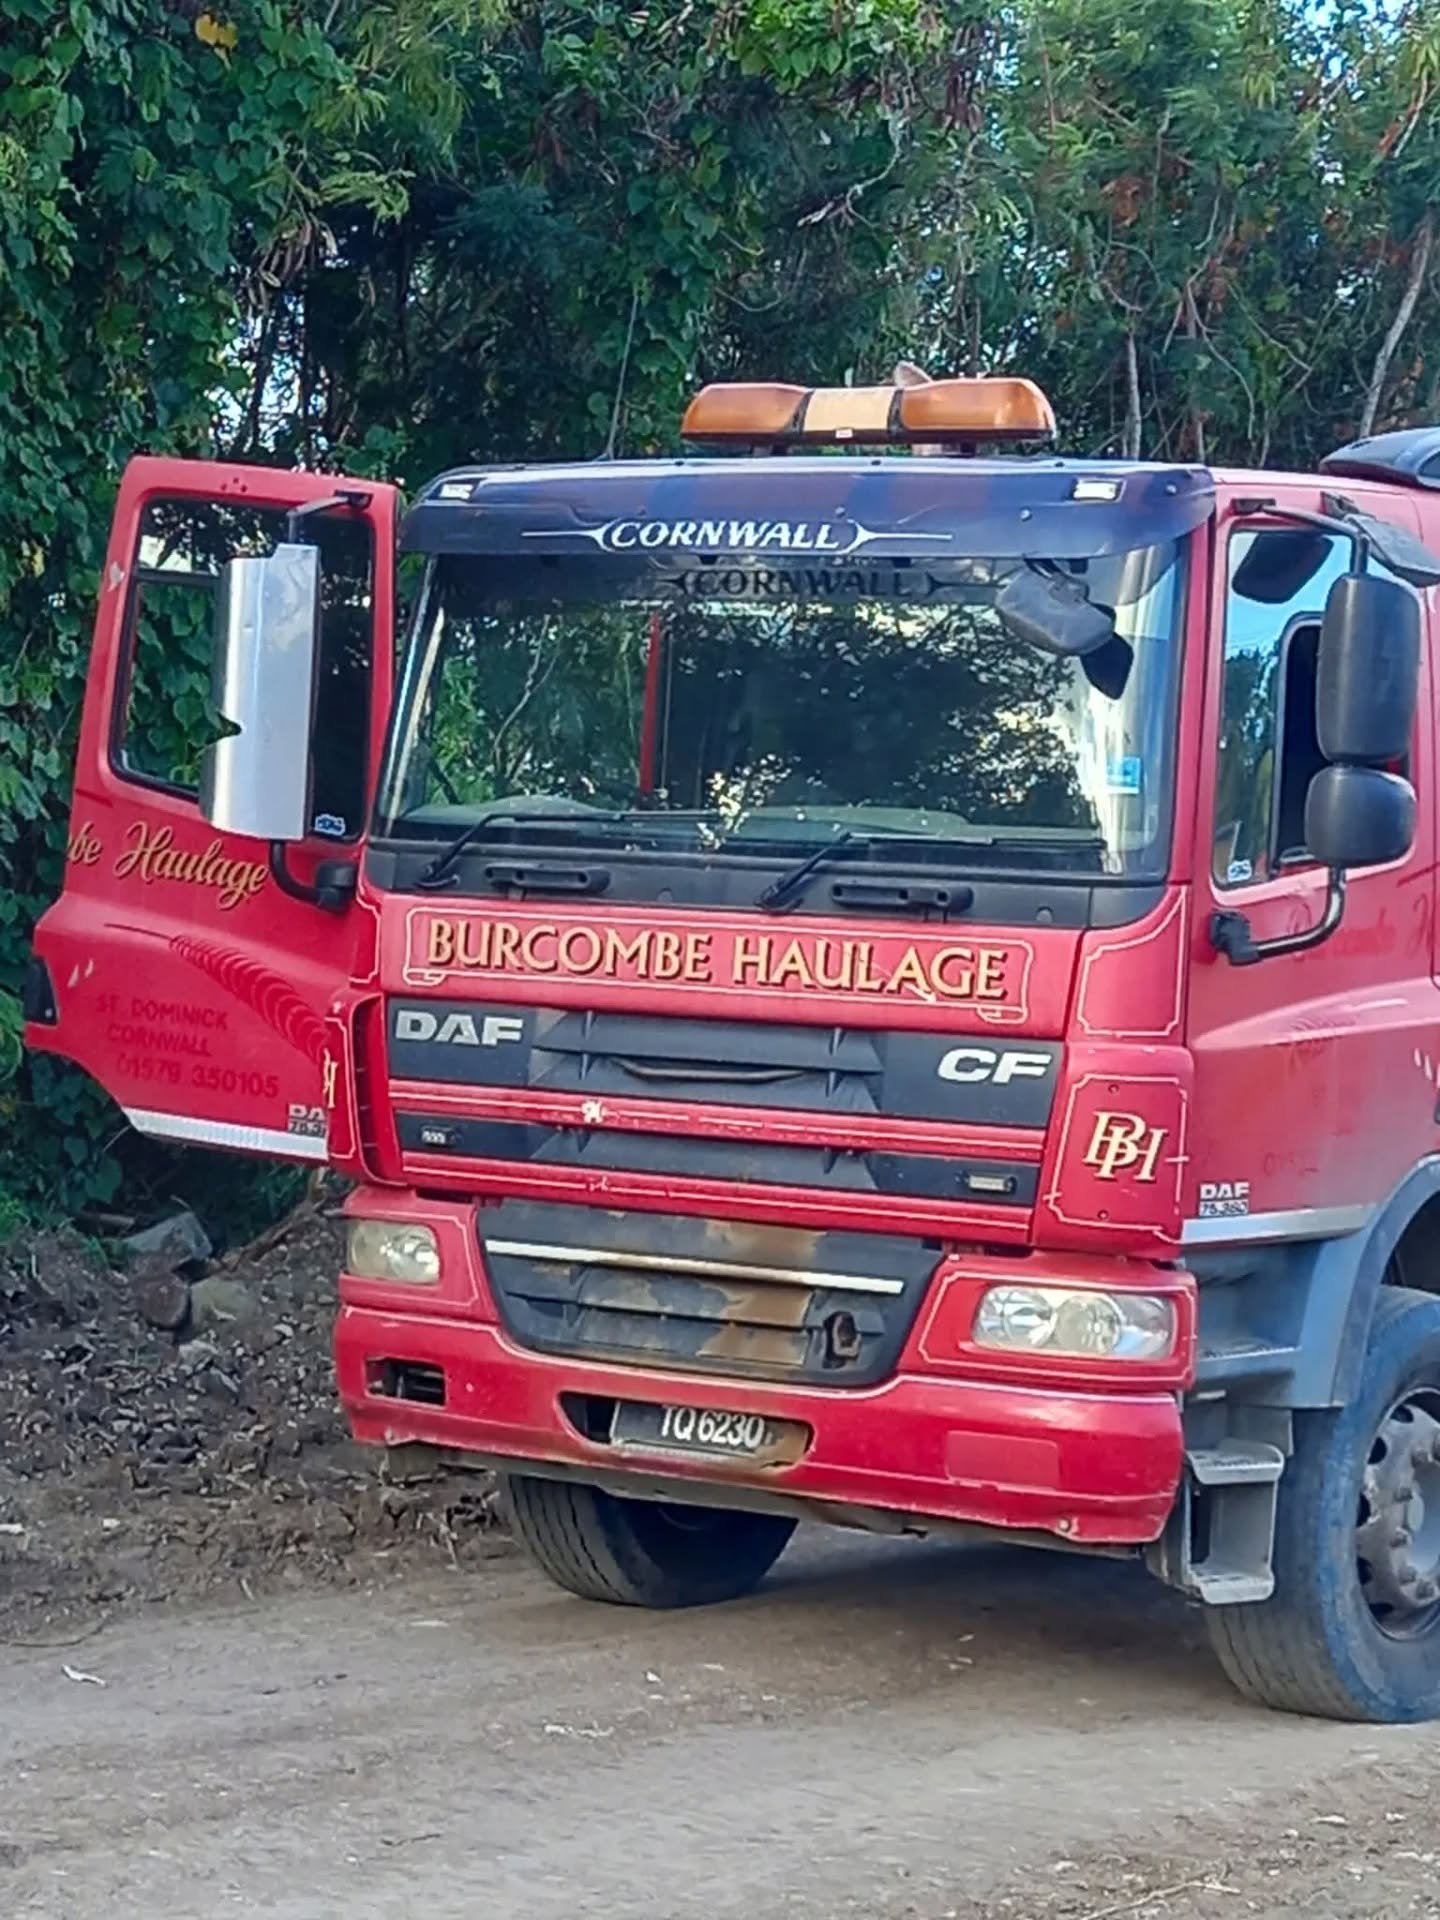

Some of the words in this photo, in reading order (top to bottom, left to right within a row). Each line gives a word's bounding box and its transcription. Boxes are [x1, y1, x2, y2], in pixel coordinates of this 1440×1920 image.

[610, 520, 839, 549] CORNWALL
[68, 821, 102, 865] be
[113, 821, 269, 911] Haulage
[427, 918, 711, 982] BURCOMBE
[733, 936, 1008, 999] HAULAGE
[131, 997, 229, 1031] DOMINICK
[395, 1010, 524, 1046] DAF
[107, 1022, 212, 1057] CORNWALL
[192, 1064, 280, 1099] 350105
[937, 1048, 1053, 1085] CF
[1200, 1181, 1250, 1199] DAF
